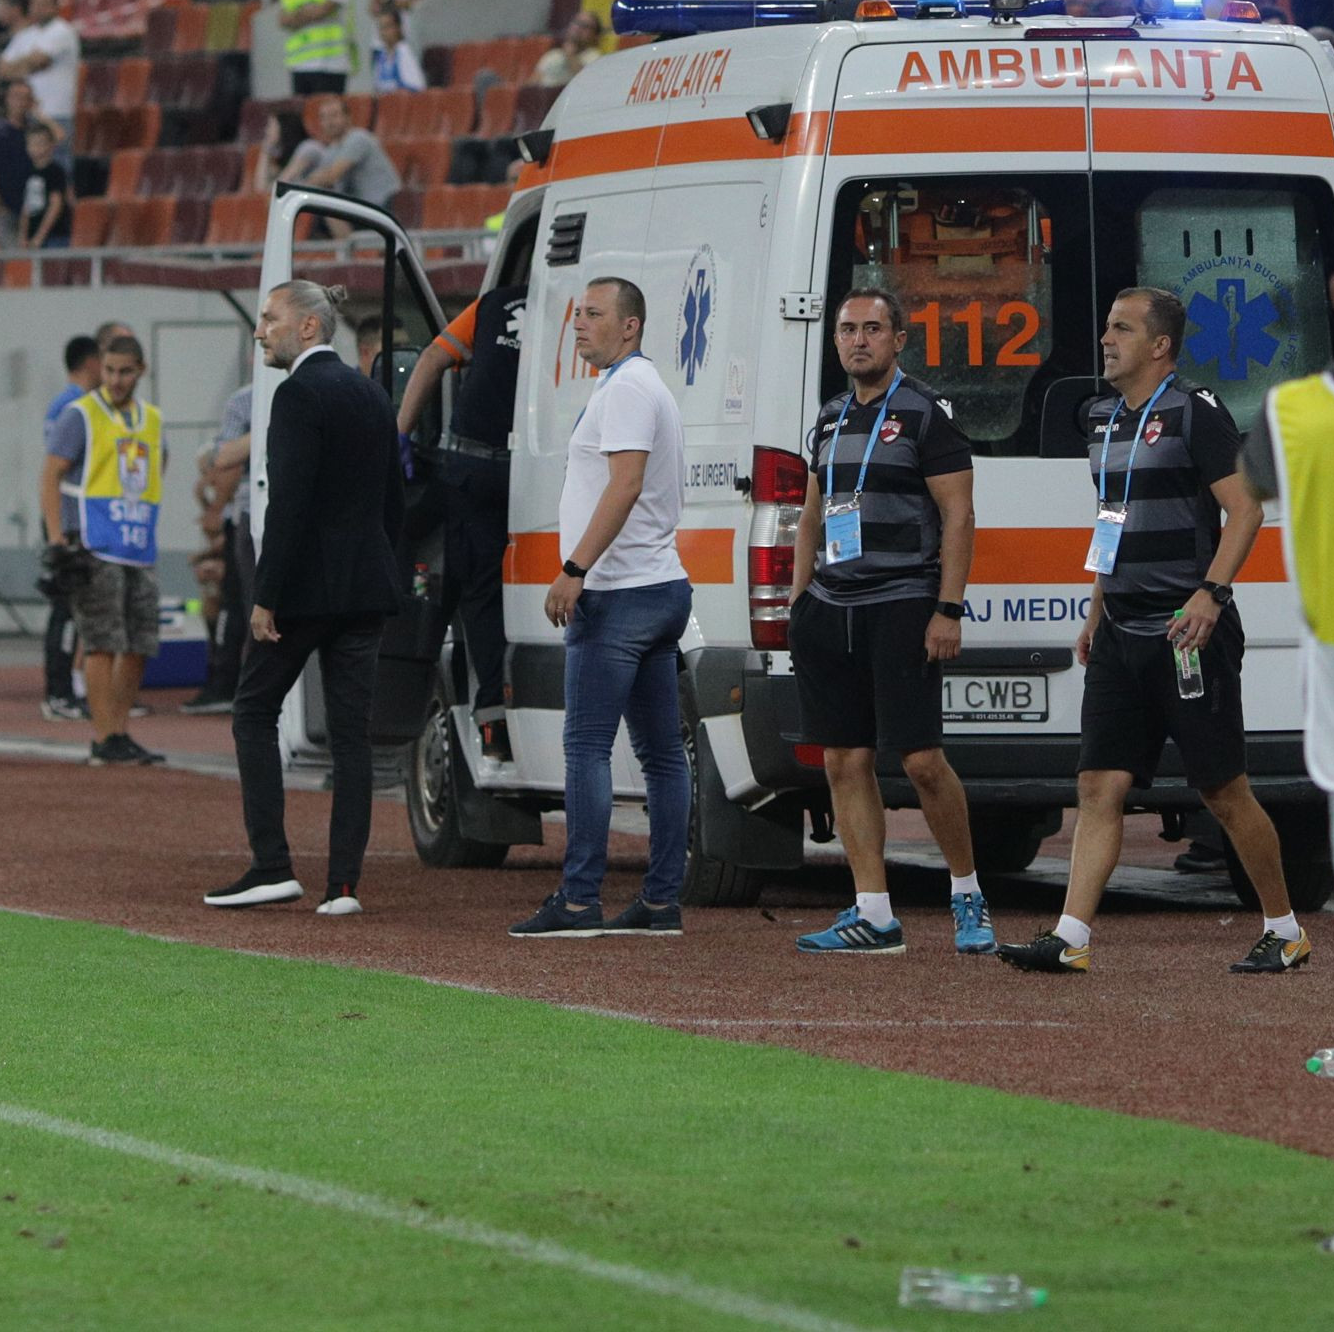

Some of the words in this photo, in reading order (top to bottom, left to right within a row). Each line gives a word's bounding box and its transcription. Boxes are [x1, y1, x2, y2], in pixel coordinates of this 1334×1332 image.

[910, 301, 1041, 367] 112
[691, 464, 702, 487] DE
[965, 681, 1032, 709] CWB
